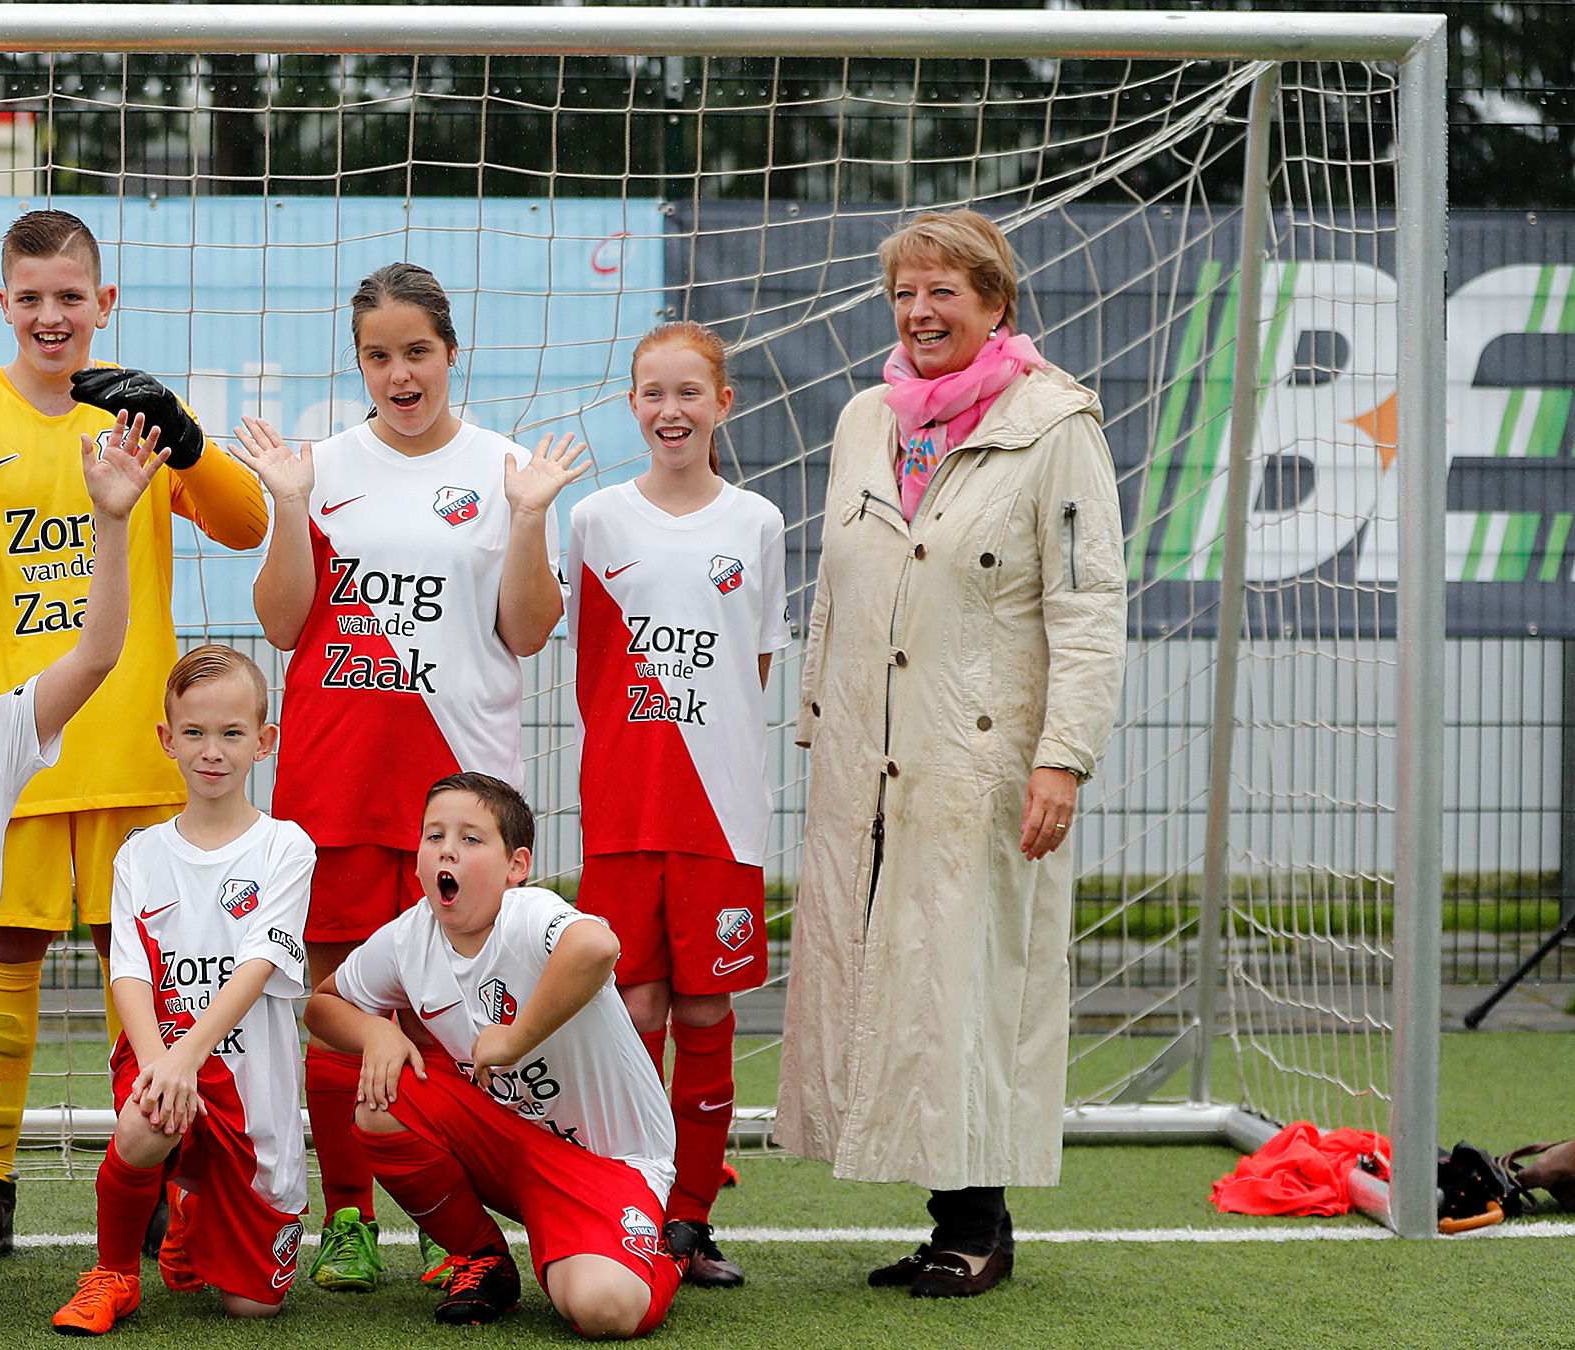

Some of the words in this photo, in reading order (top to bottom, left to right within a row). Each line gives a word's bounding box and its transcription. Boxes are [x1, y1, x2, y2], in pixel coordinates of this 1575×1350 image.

[439, 493, 477, 517] UTRECHT
[458, 508, 469, 520] C
[5, 508, 97, 555] Zor
[21, 561, 67, 582] van
[714, 562, 742, 585] UTRECHT
[727, 578, 737, 588] C
[331, 558, 446, 622] Zorg
[14, 593, 89, 635] Zaa
[338, 615, 381, 635] van
[385, 613, 415, 636] de
[628, 616, 719, 668] Zorg
[323, 645, 437, 693] Zaak
[636, 662, 670, 678] van
[672, 660, 694, 679] de
[629, 686, 707, 726] Zaak
[226, 884, 258, 911] UTRECHT
[241, 901, 251, 912] C
[722, 912, 750, 942] UTRECHT
[166, 996, 195, 1013] van
